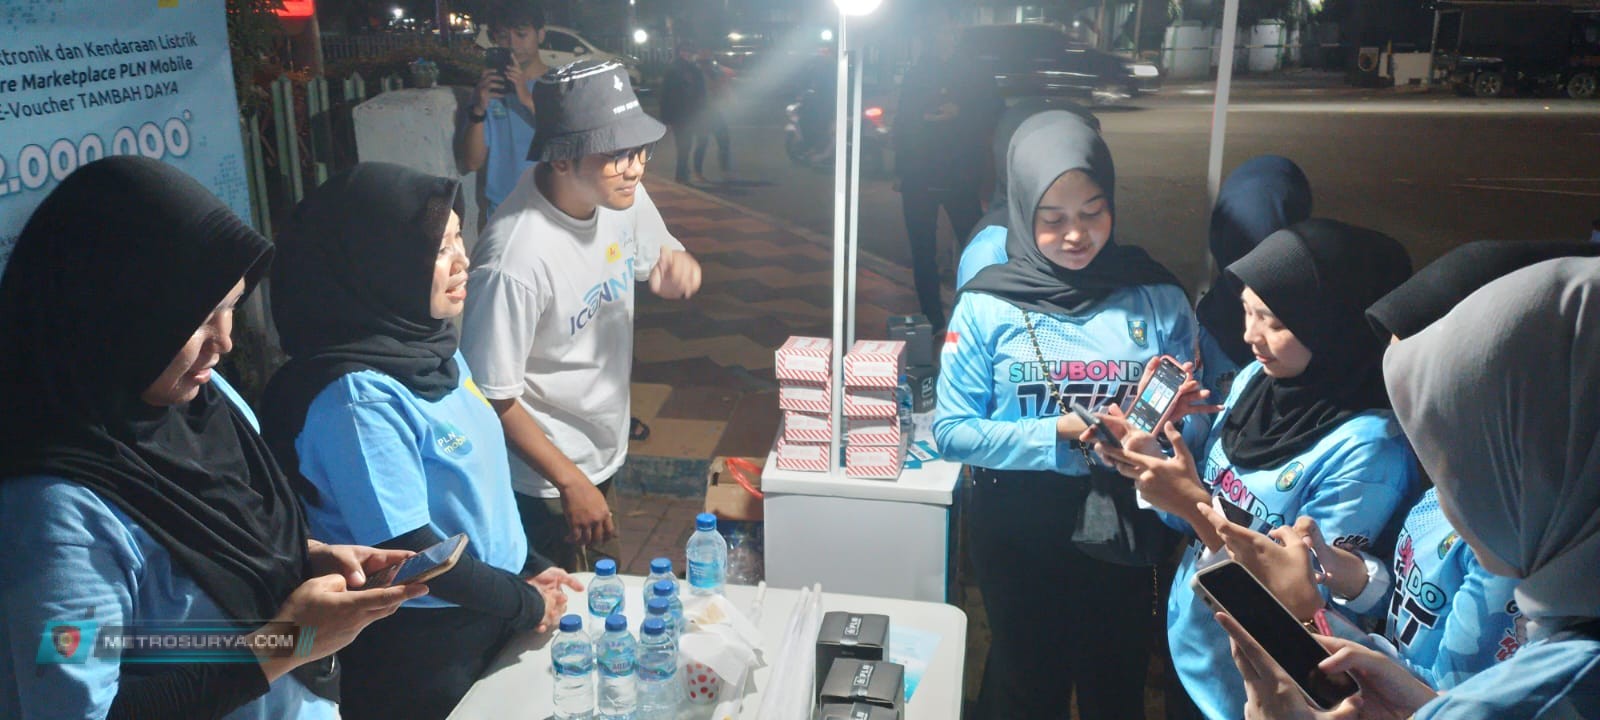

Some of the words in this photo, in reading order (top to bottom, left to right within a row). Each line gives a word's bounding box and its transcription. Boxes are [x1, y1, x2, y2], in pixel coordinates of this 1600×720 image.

[56, 43, 84, 61] dan
[84, 37, 157, 57] Kendaraan
[158, 31, 198, 50] Listrik
[22, 67, 116, 90] Marketplace
[119, 62, 147, 79] PLN
[150, 55, 193, 74] Mobile
[78, 85, 142, 109] TAMBAH
[144, 81, 179, 98] DAYA
[1009, 360, 1143, 382] SITUBOND
